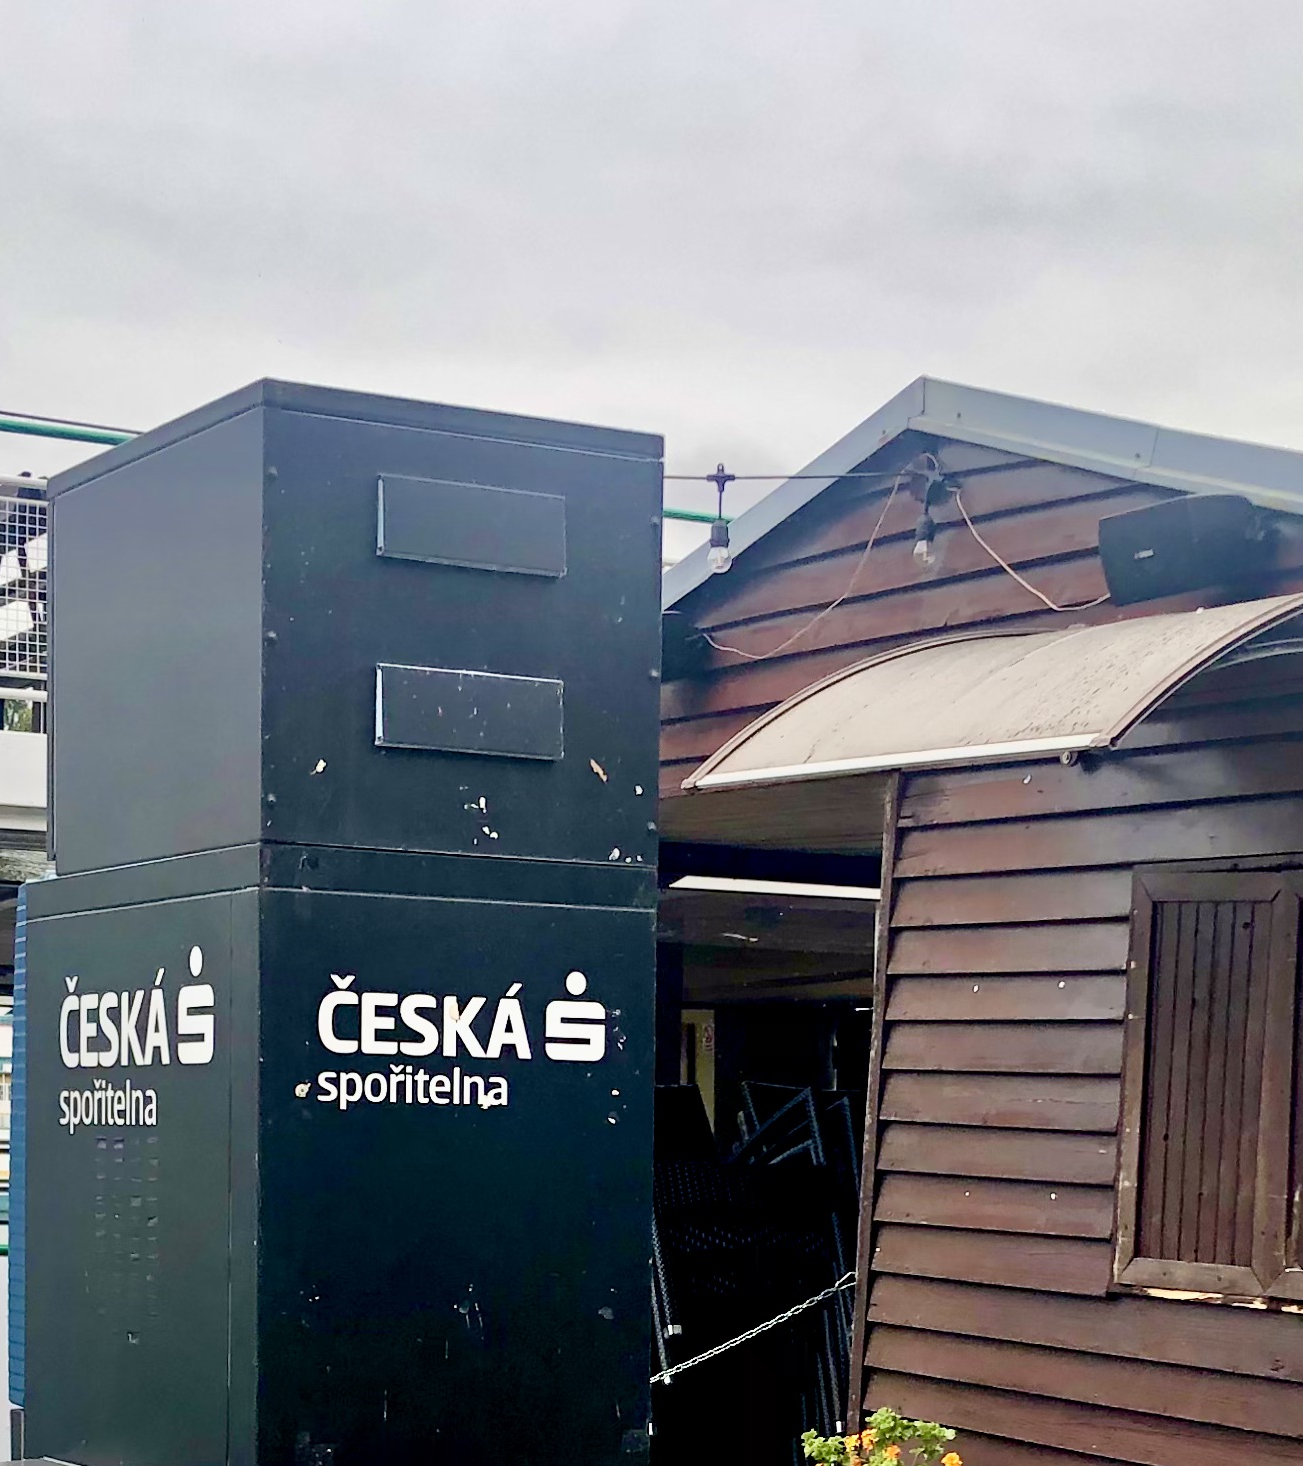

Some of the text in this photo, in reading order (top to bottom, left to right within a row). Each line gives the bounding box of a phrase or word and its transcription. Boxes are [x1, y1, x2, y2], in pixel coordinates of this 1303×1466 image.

[59, 968, 170, 1069] ČESKÁ
[318, 974, 531, 1060] ČESKÁ
[59, 1079, 157, 1133] spořitelna
[317, 1064, 508, 1109] spořitelna
